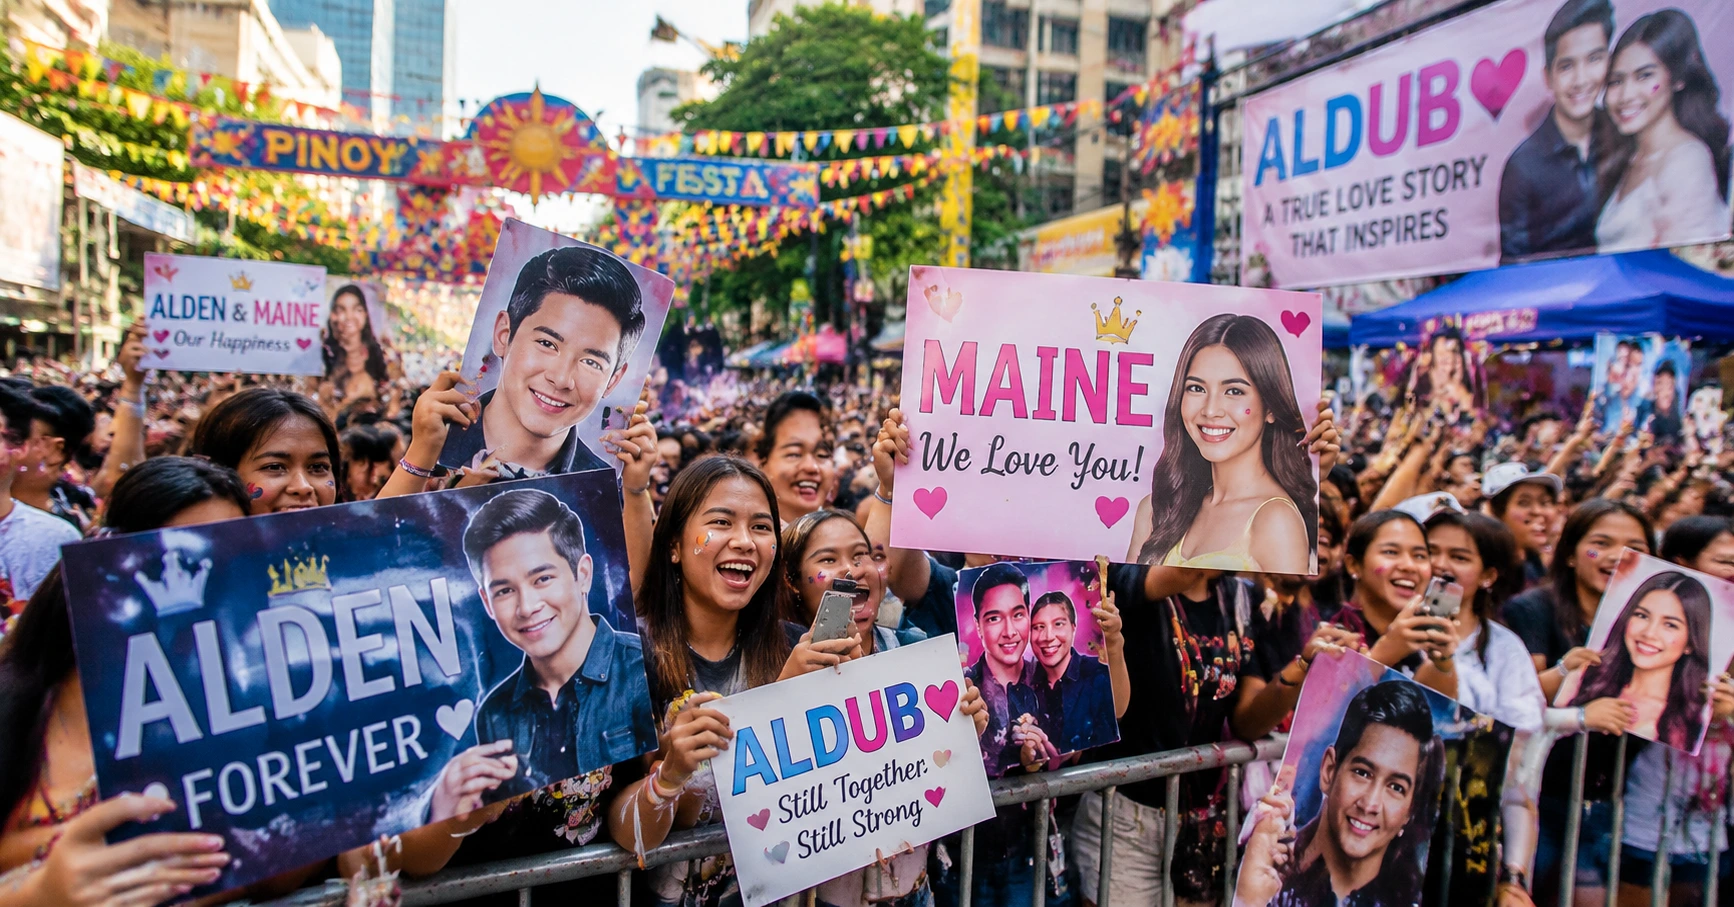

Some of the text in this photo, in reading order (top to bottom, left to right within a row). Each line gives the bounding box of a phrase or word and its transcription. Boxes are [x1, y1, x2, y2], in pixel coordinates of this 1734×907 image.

[263, 129, 407, 174] PINOY
[1254, 59, 1462, 187] ALDUB
[1263, 154, 1487, 226] A TRUE LOVE STORY
[1290, 208, 1449, 256] THAT INSPIRES
[150, 294, 320, 328] ALDEN & MAINE
[173, 329, 291, 354] Our Happiness
[919, 339, 1154, 427] MAINE
[919, 431, 1144, 490] We Love You!
[114, 577, 462, 760] ALDEN
[731, 682, 925, 796] ALDUB
[181, 714, 429, 830] FOREVER
[778, 783, 828, 824] Still
[797, 799, 923, 859] Still Strong
